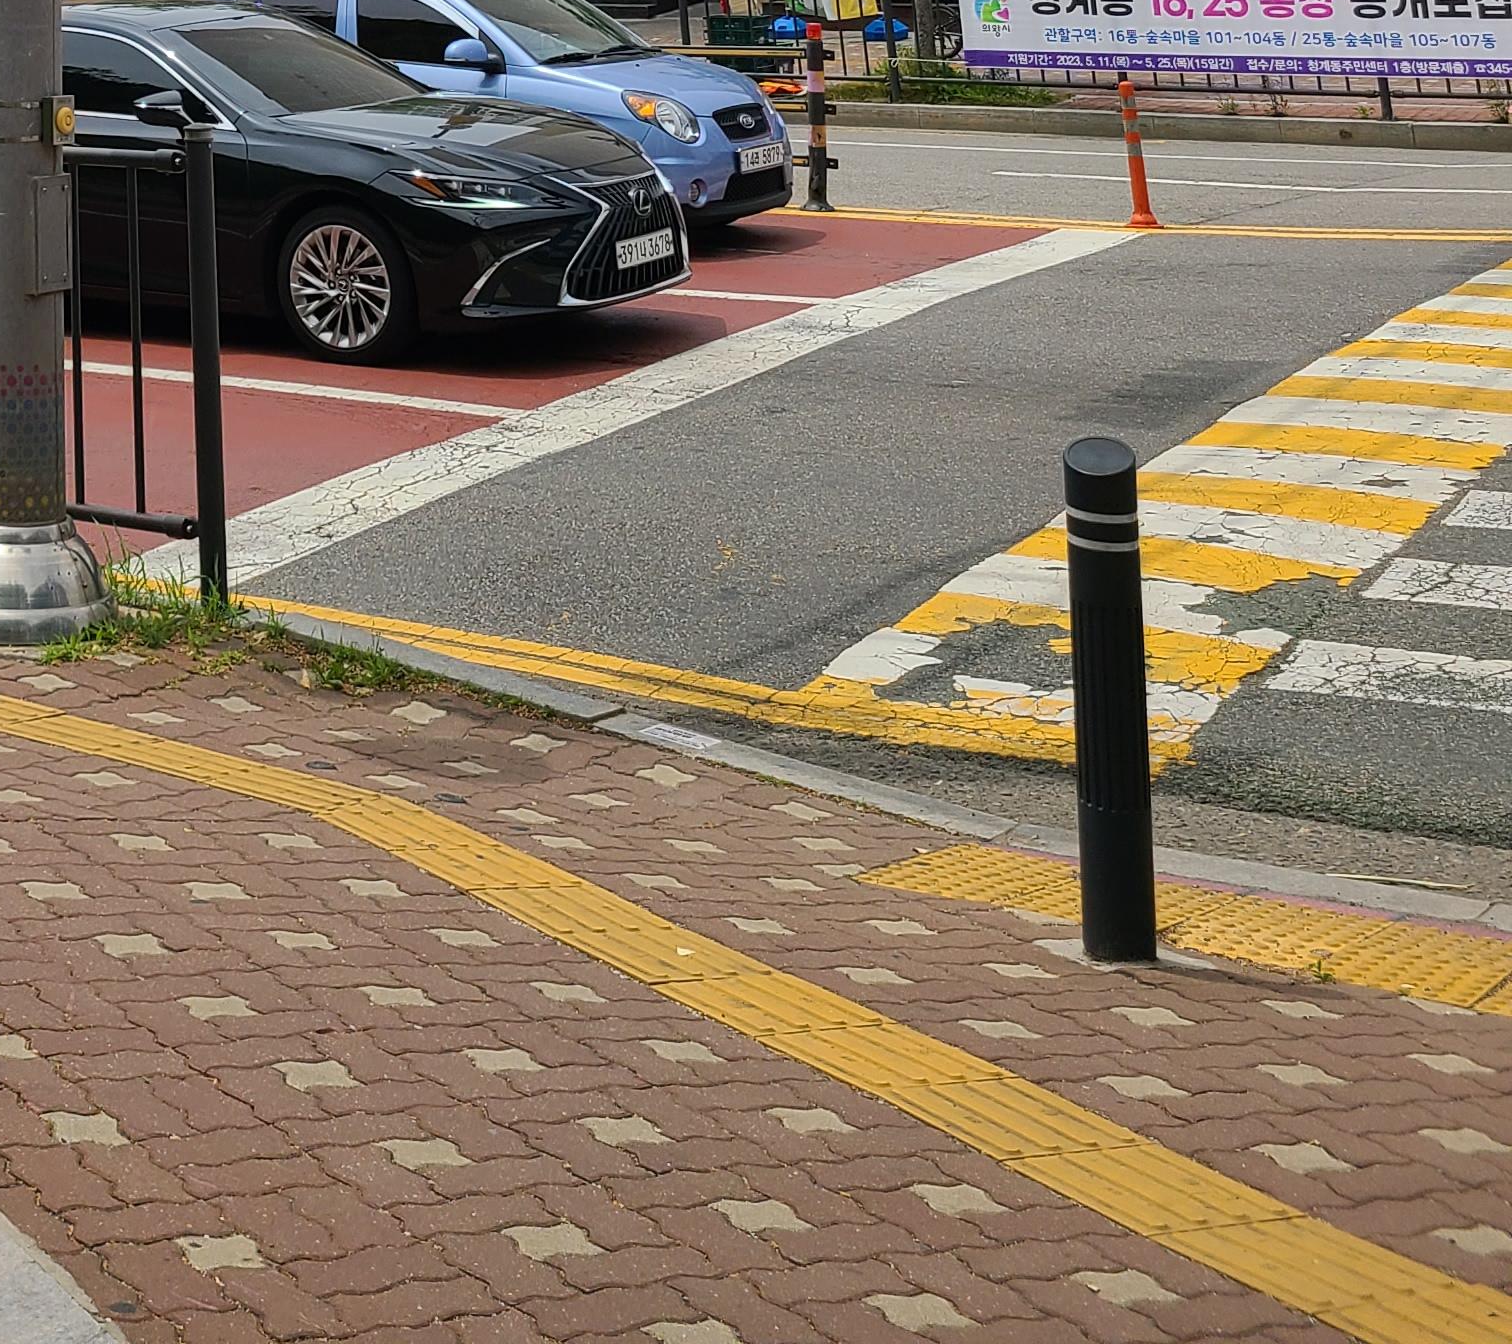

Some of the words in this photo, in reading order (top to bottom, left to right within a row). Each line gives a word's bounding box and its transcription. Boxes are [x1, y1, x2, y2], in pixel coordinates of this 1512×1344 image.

[981, 23, 1012, 38] 의왕시
[1044, 28, 1102, 44] 관할구역:
[1206, 31, 1287, 47] 101~104동
[1291, 32, 1297, 47] /
[1302, 31, 1404, 49] 25통-숲속마을
[1409, 33, 1497, 50] 105~107동
[1007, 53, 1053, 66] 지원기간:
[1246, 58, 1302, 72] 접수/문의:
[1307, 60, 1388, 73] 청계동주민센터
[647, 232, 671, 257] 3678
